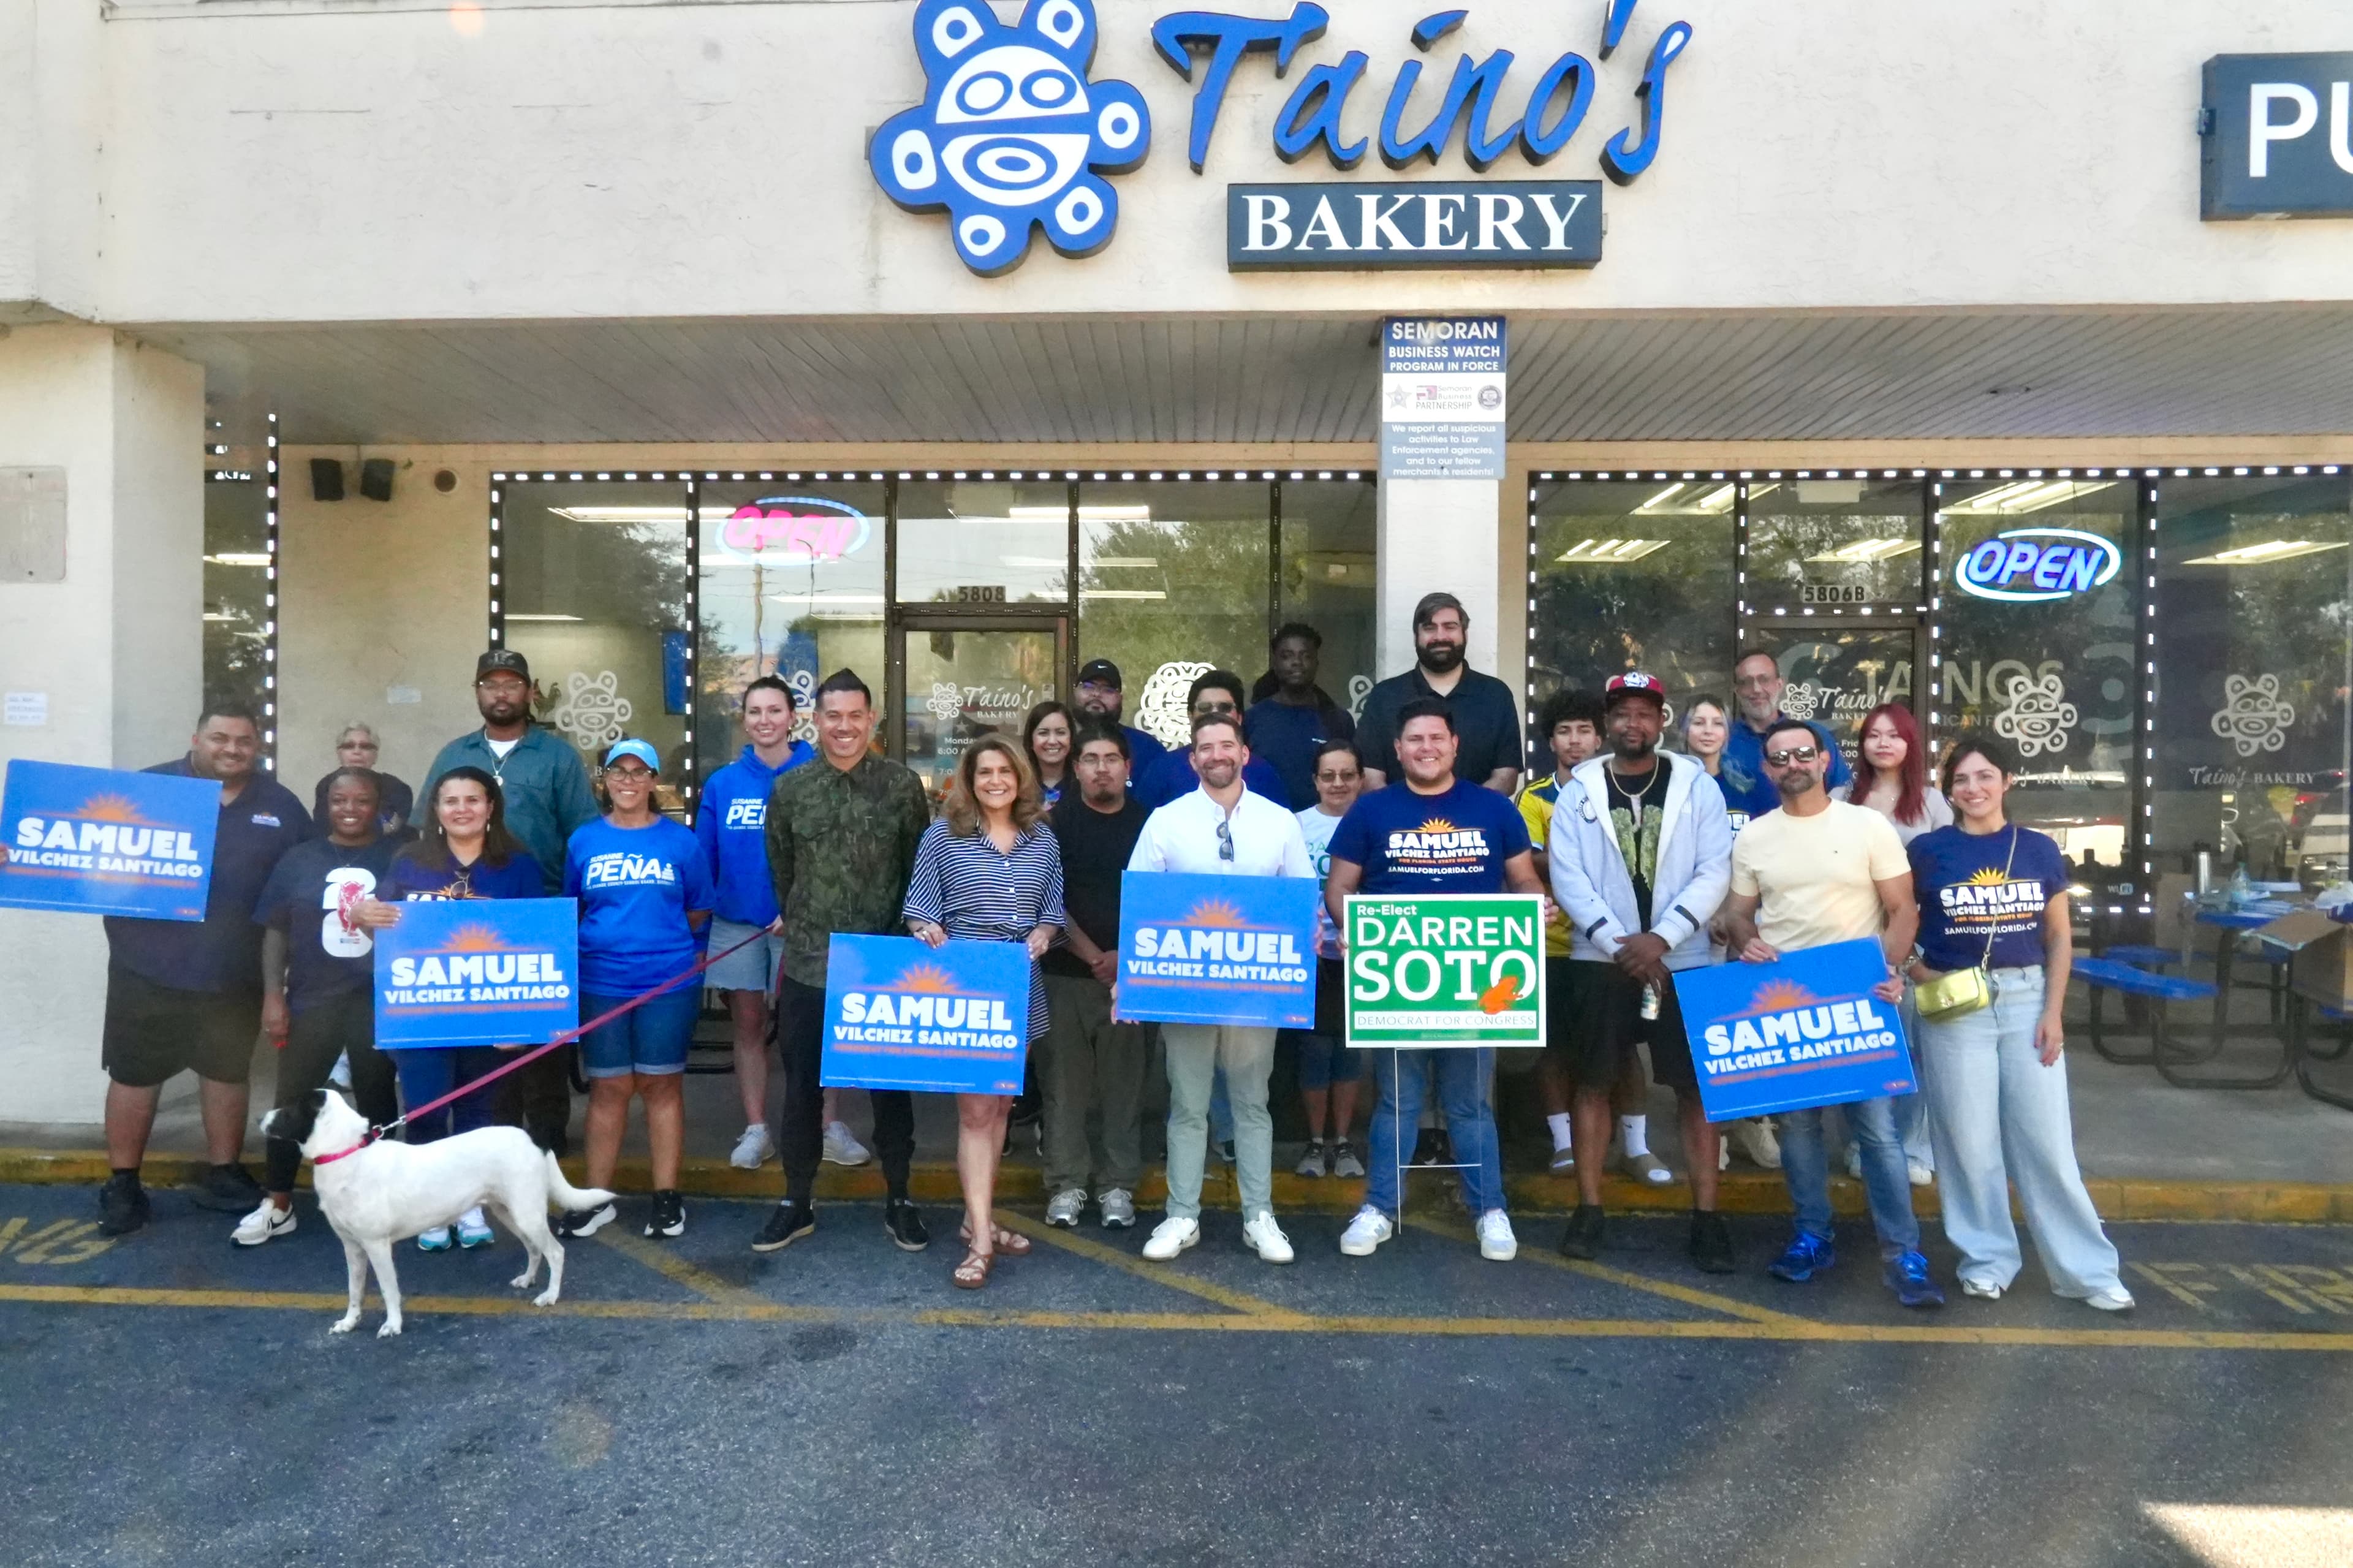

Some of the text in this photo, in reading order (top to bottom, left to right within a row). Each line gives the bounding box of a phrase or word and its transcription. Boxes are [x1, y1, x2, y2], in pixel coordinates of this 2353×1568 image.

[1241, 194, 1587, 251] BAKERY
[1392, 322, 1498, 339] SEMORAN
[1389, 346, 1500, 357] BUSINESS WATCH
[1390, 362, 1498, 371] PROGRAM IN FORCE
[1408, 425, 1436, 434] report
[1451, 425, 1496, 434] suspicious
[1451, 447, 1495, 456] agencies,
[724, 506, 855, 559] OPEN
[1966, 540, 2104, 591] OPEN
[958, 586, 1006, 602] 5808
[1805, 586, 1865, 602] 5806B
[2254, 773, 2316, 784] BAKERY
[17, 817, 199, 862] SAMUEL
[1389, 831, 1486, 850] SAMUEL
[7, 848, 93, 869] VILCHEZ
[99, 857, 202, 877] SANTIAGO
[1385, 847, 1490, 858] VILCHEZ SANTIAGO
[586, 854, 661, 886] PEÑA
[1388, 866, 1484, 874] SAMUELFORFLORIDA.COM
[1940, 882, 2044, 907] SAMUEL
[1357, 904, 1417, 915] Re-Elect
[1990, 902, 2045, 915] SANTIAGO
[1357, 917, 1532, 946] DARREN
[1135, 928, 1301, 964] SAMUEL
[391, 953, 563, 987] SAMUEL
[1127, 960, 1308, 982] VILCHEZ SANTIAGO
[1354, 950, 1537, 1001] SOTO
[384, 985, 570, 1004] VILCHEZ SANTIAGO
[842, 993, 1012, 1031] SAMUEL
[1358, 1015, 1534, 1026] DEMOCRAT FOR CONGRESS
[833, 1026, 1017, 1048] VILCHEZ SANTIAGO
[1705, 999, 1885, 1056] SAMUEL
[1704, 1049, 1786, 1074] VILCHEZ
[1789, 1031, 1896, 1062] SANTIAGO
